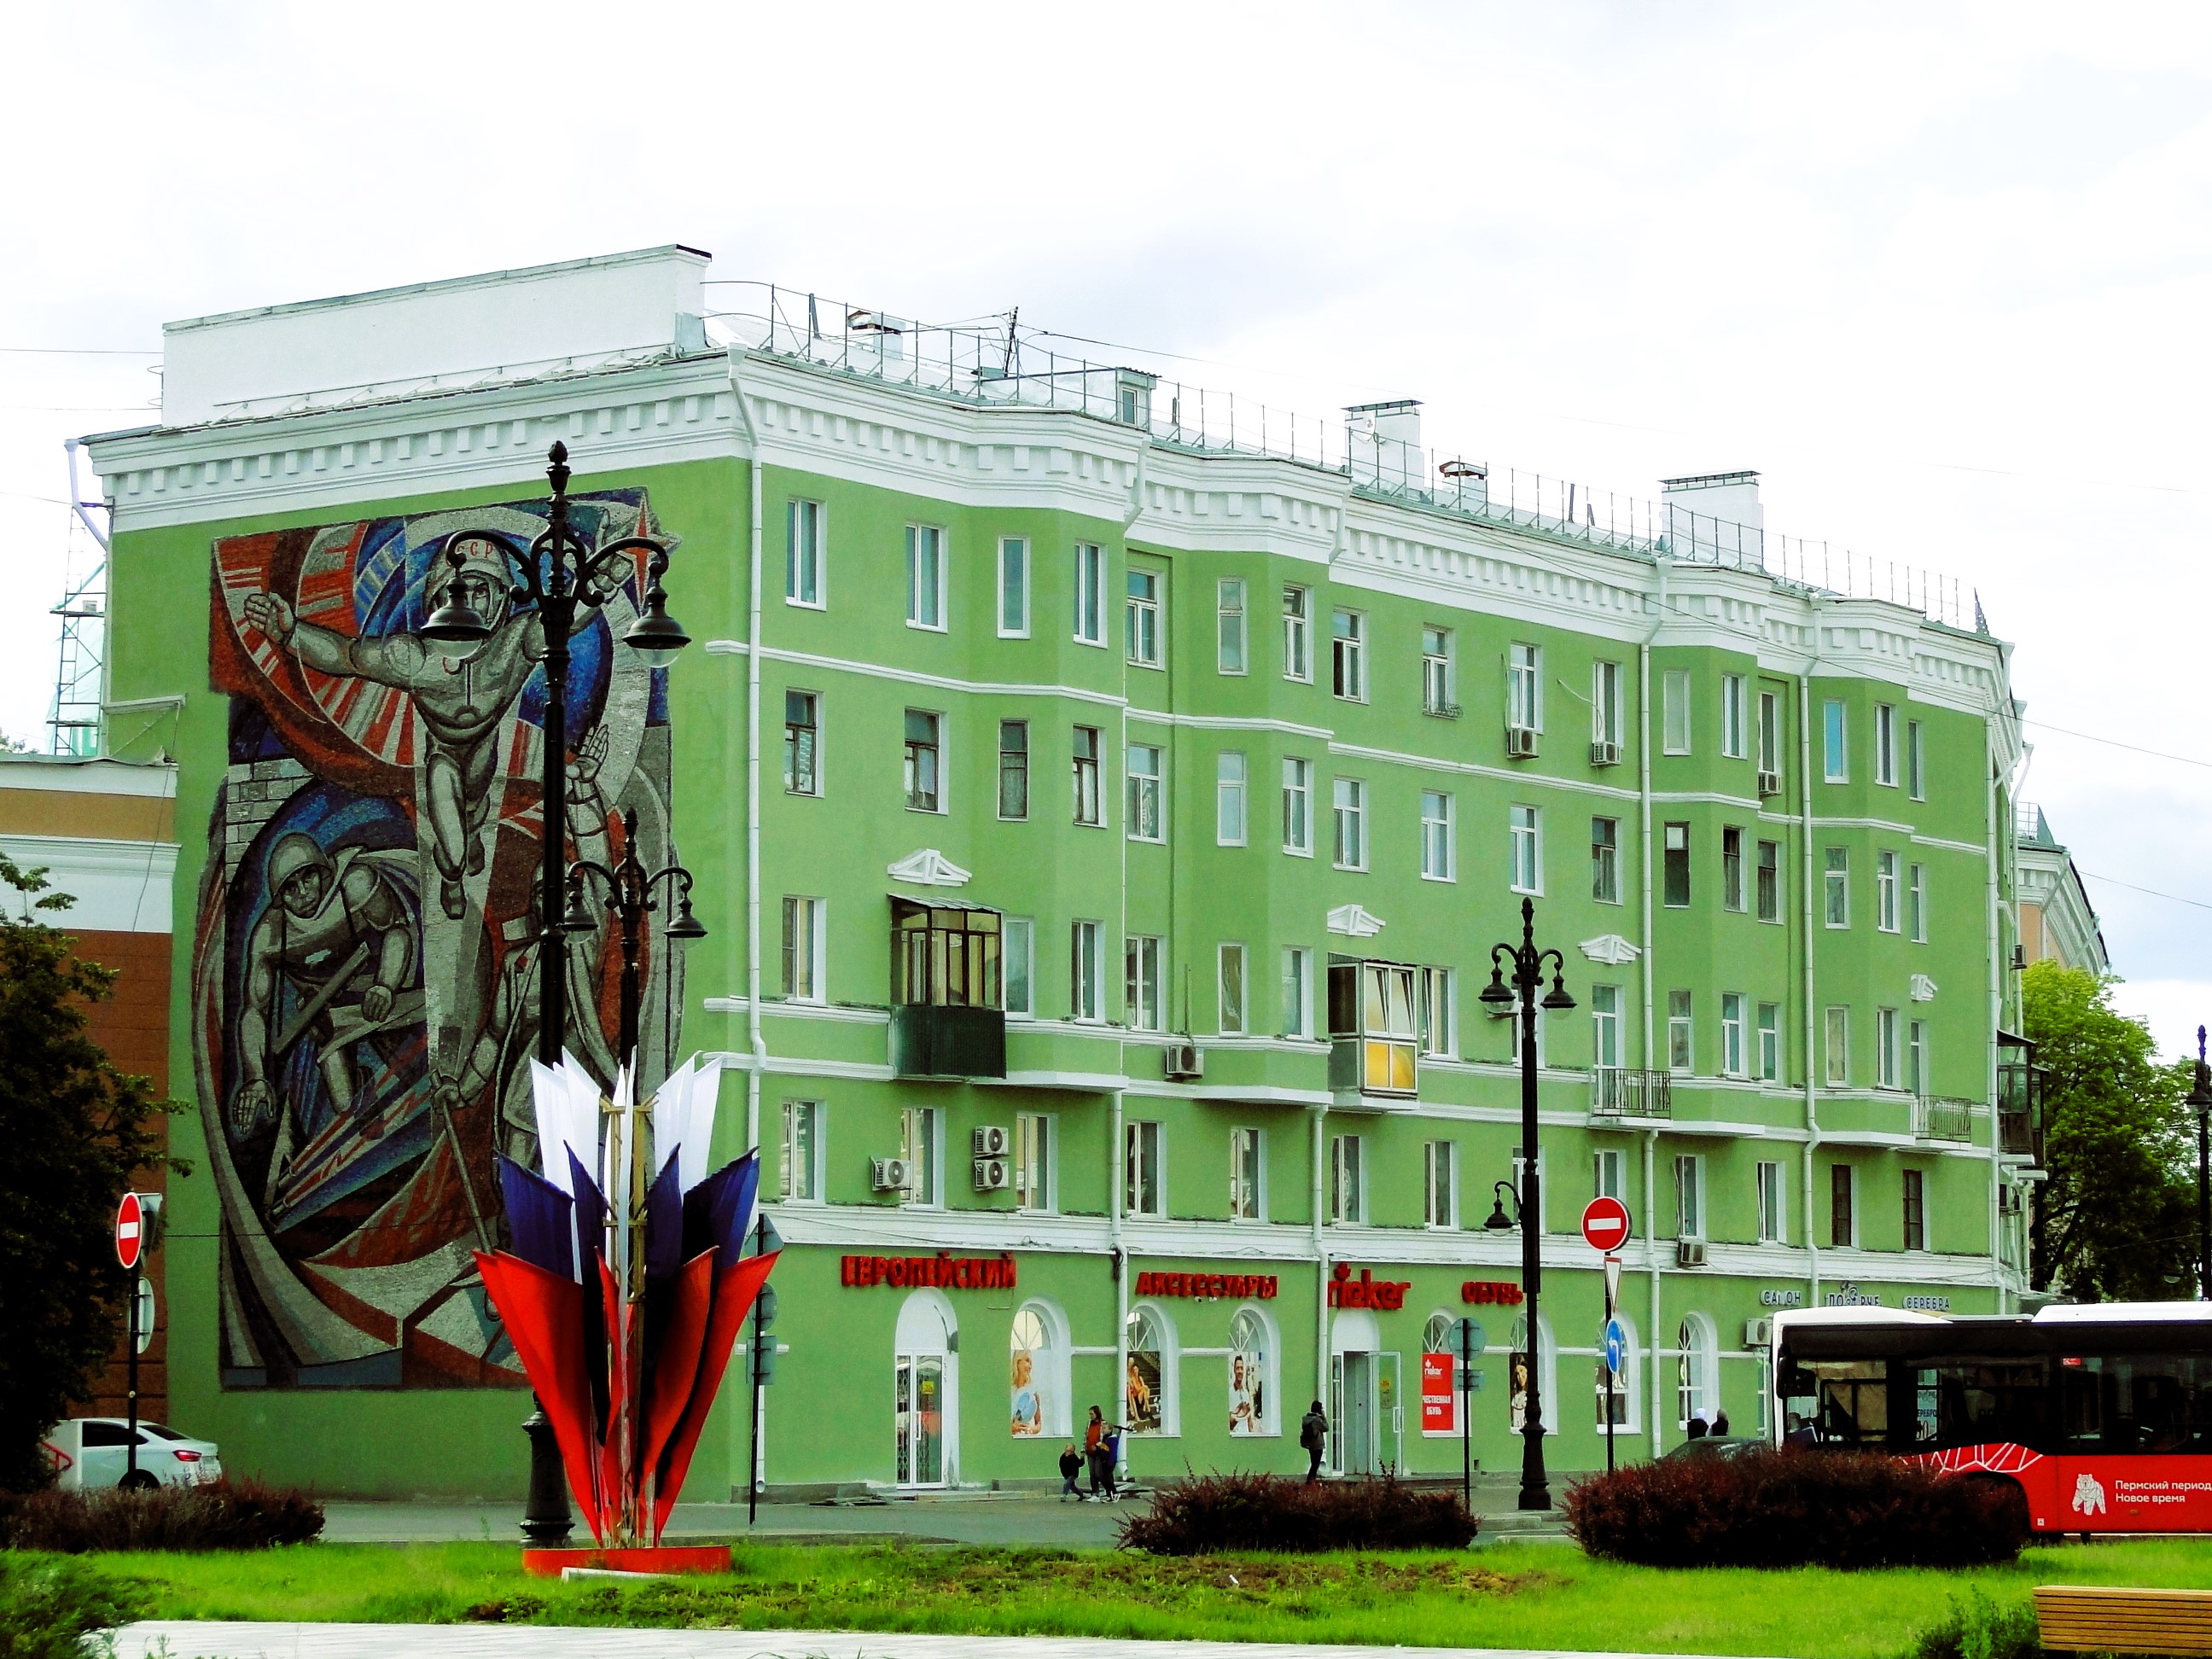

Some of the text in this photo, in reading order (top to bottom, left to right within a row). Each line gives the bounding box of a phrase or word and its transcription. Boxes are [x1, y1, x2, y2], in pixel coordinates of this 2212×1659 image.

[841, 1251, 1016, 1289] ЕВРОПЕЙСКИЙ
[1135, 1272, 1278, 1298] АКСЕССУАРЫ
[1328, 1265, 1411, 1309] rieker
[1461, 1281, 1524, 1305] ОБУВЬ
[1761, 1290, 1801, 1305] САОН
[1903, 1295, 1950, 1309] СЕРЕБРА
[2115, 1480, 2168, 1492] Пермский
[2116, 1493, 2186, 1505] Новое время
